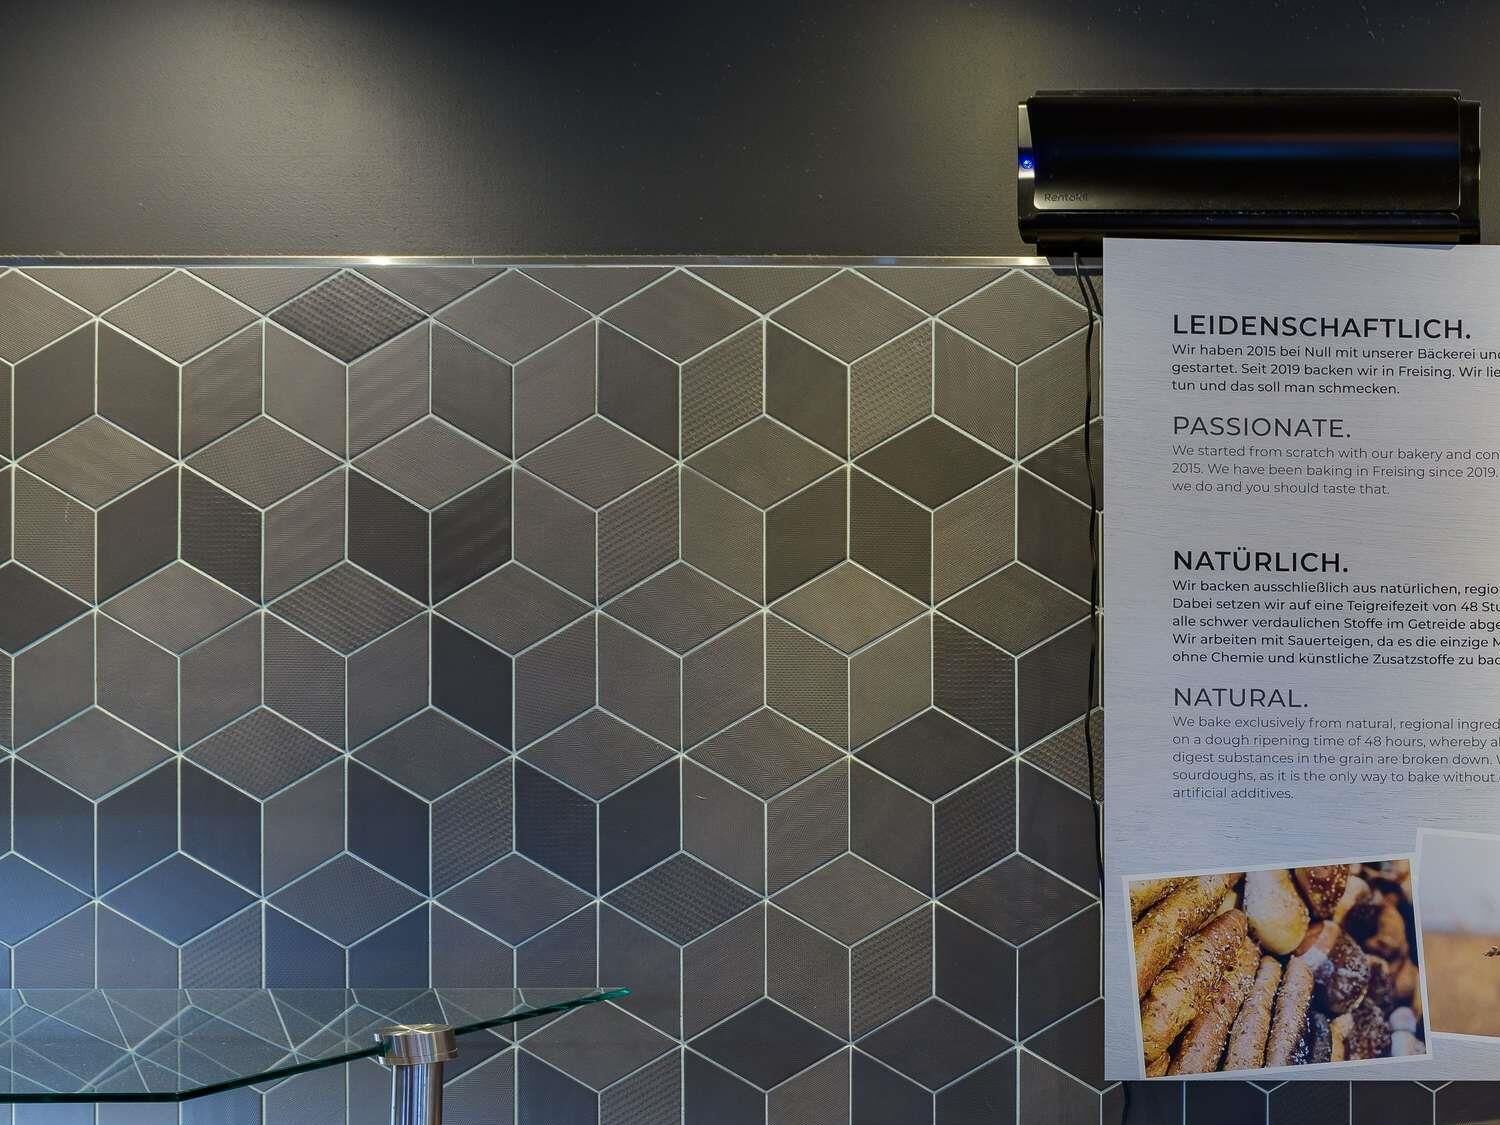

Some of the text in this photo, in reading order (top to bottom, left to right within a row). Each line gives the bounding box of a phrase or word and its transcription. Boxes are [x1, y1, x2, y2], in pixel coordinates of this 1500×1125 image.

[1044, 192, 1088, 201] Rentokil
[1173, 313, 1471, 340] LEIDENSCHAFTLICH.
[1172, 344, 1195, 354] Wir
[1200, 344, 1242, 355] haben
[1247, 345, 1275, 356] 2015
[1280, 345, 1299, 356] bei
[1305, 346, 1330, 357] Null
[1336, 347, 1358, 358] mit
[1362, 350, 1413, 358] unserer
[1418, 348, 1475, 359] Bäckerei
[1172, 380, 1399, 394] tun und das soll man schmecken.
[1173, 415, 1351, 438] PASSIONATE.
[1173, 545, 1348, 573] NATÜRLICH.
[1173, 579, 1196, 590] Wir
[1201, 580, 1249, 591] backen
[1254, 581, 1348, 592] ausschließlich
[1353, 585, 1376, 593] aus
[1381, 583, 1460, 595] natürlichen,
[1171, 615, 1195, 626] alle
[1200, 616, 1248, 627] schwer
[1252, 617, 1339, 628] verdaulichen
[1344, 617, 1384, 628] Stoffe
[1387, 618, 1403, 628] im
[1408, 618, 1465, 630] Getreide
[1174, 687, 1308, 708] NATURAL.
[1173, 716, 1194, 726] We
[1199, 716, 1231, 727] bake
[1233, 716, 1305, 730] exclusively
[1309, 717, 1341, 728] from
[1346, 718, 1396, 730] natural,
[1400, 718, 1453, 731] regional
[1172, 787, 1295, 798] artificial additives.
